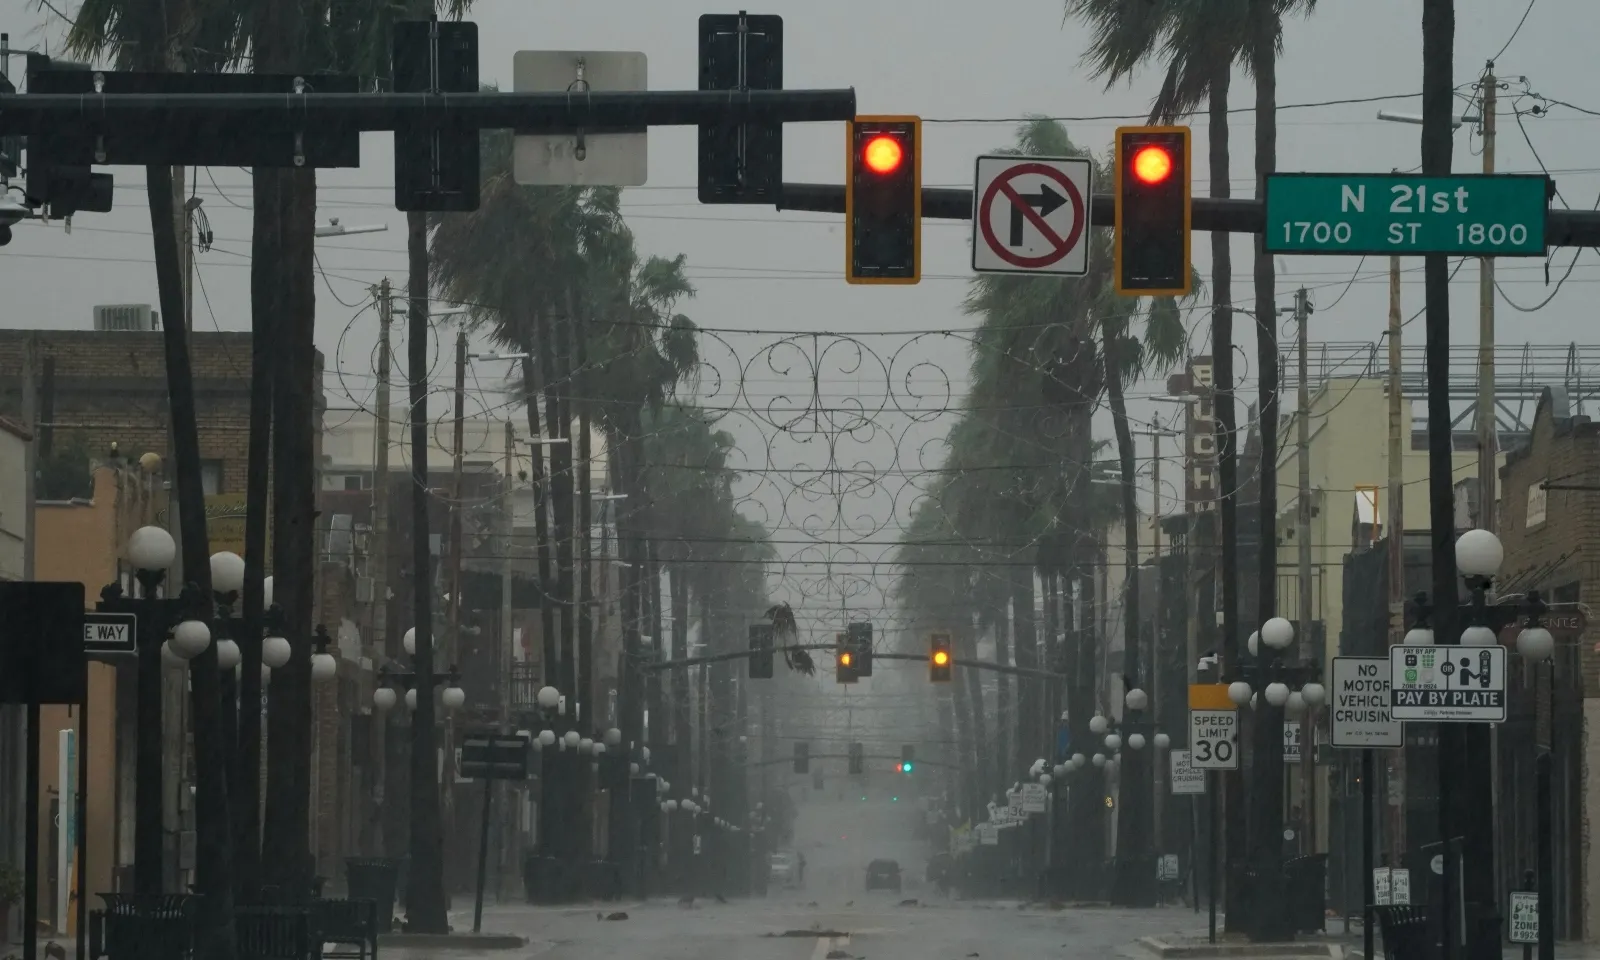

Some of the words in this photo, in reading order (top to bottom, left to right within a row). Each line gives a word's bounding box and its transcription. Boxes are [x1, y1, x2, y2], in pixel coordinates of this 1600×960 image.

[1341, 185, 1365, 212] N
[1389, 184, 1469, 213] 21st
[1283, 221, 1351, 243] 1700
[1387, 222, 1422, 244] ST
[1456, 223, 1528, 245] 1800
[98, 625, 124, 640] WAY
[1358, 664, 1378, 677] NO
[1442, 665, 1453, 673] OR
[1344, 680, 1390, 692] MOTOR
[1339, 695, 1388, 707] VEHICL
[1397, 691, 1424, 705] PAY
[1429, 691, 1447, 705] BY
[1453, 691, 1498, 706] PLATE
[1194, 716, 1234, 726] SPEED
[1336, 710, 1391, 723] CRUISIN
[1198, 728, 1229, 738] LIMIT
[1195, 740, 1233, 762] 30
[1514, 921, 1538, 930] ZONE
